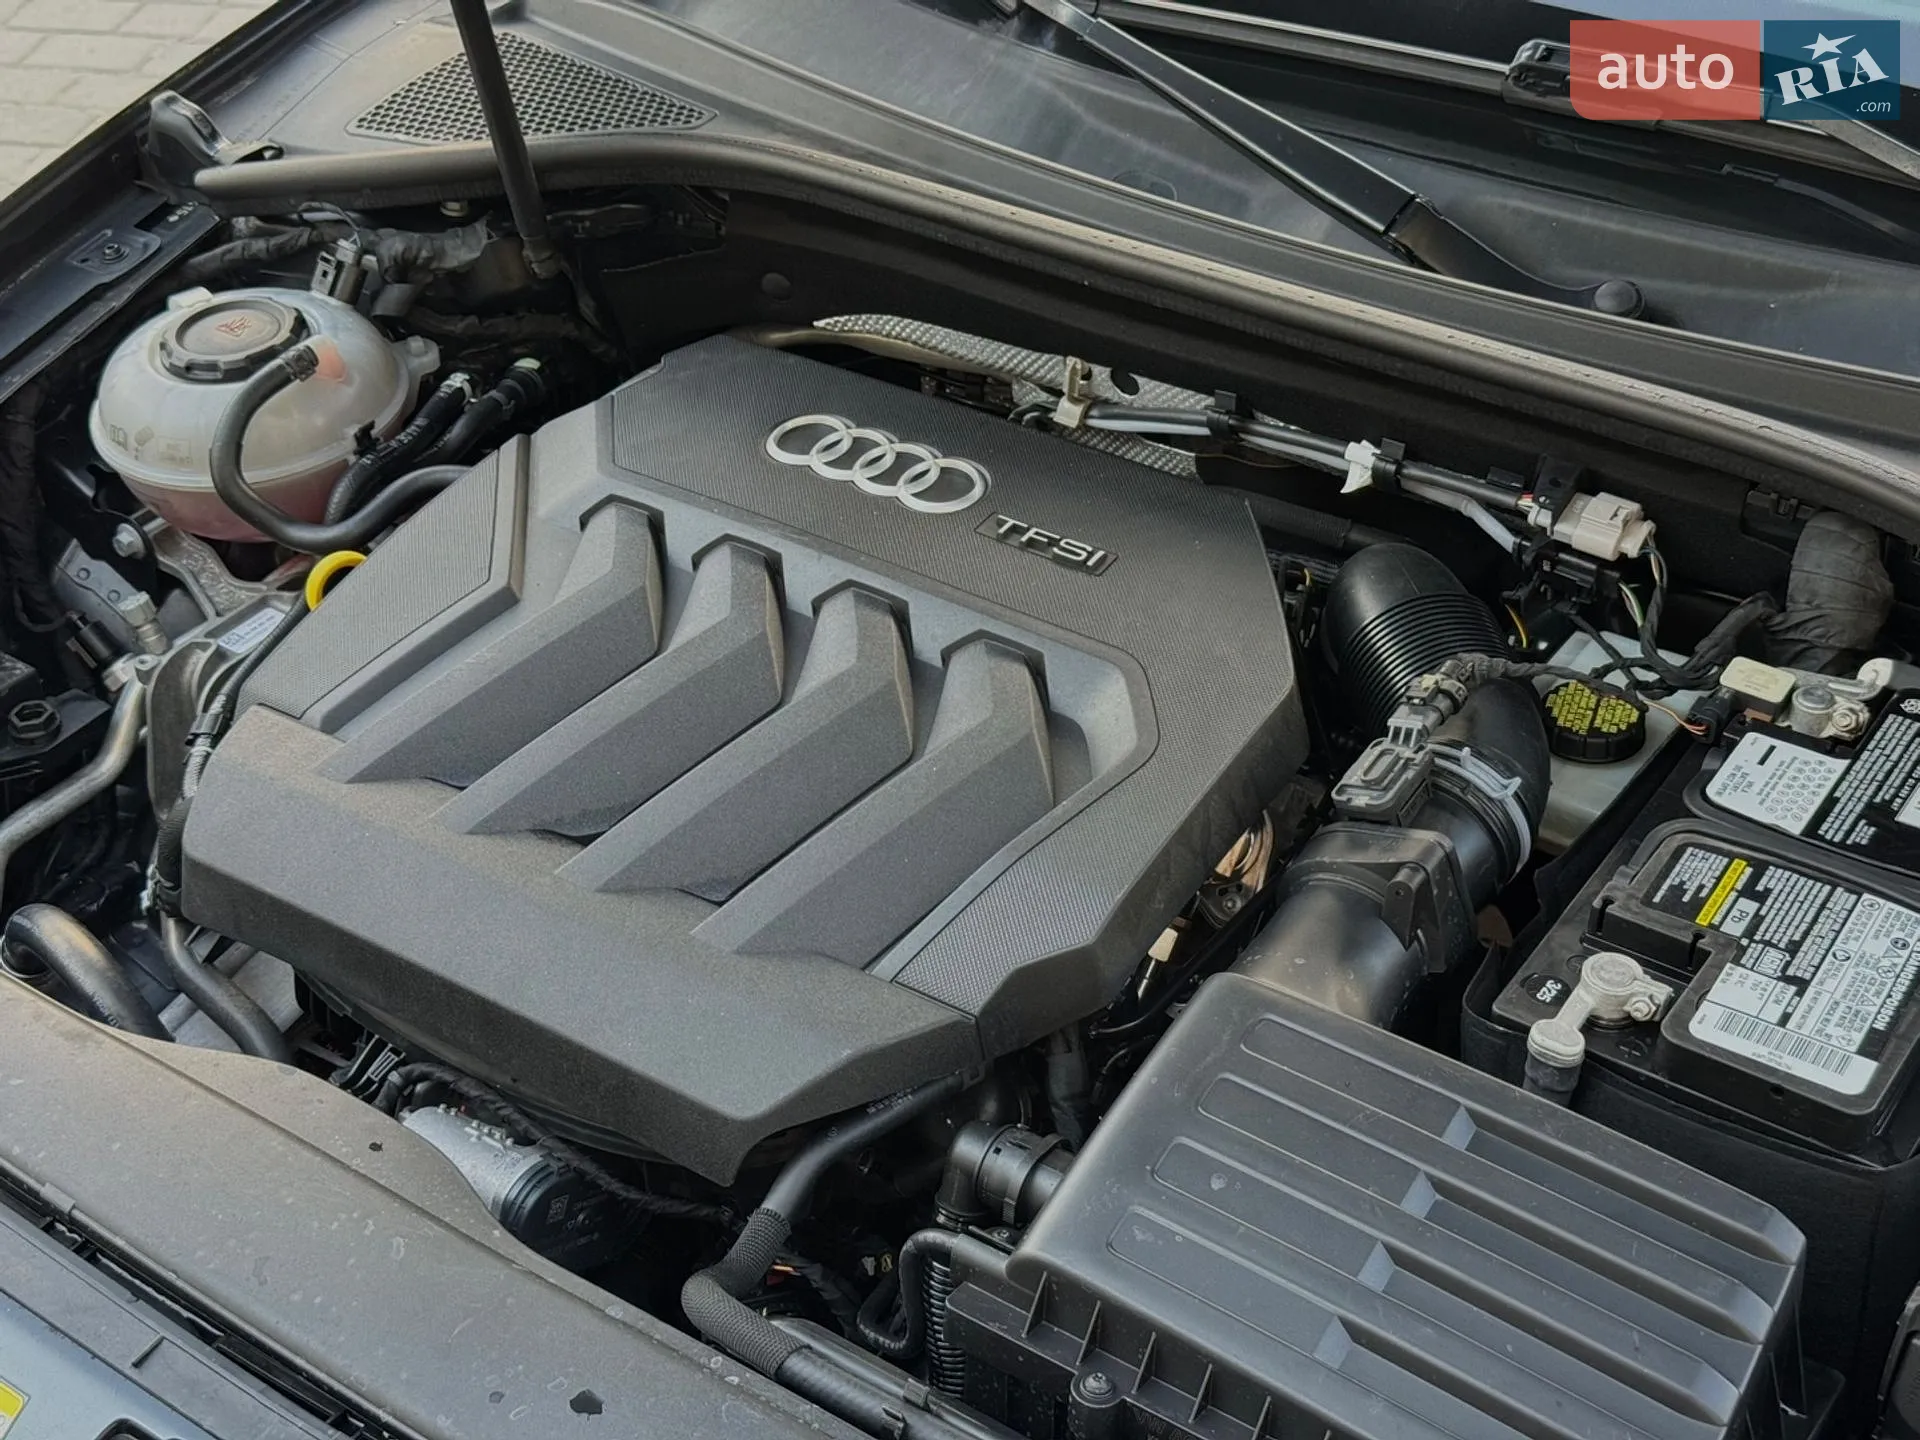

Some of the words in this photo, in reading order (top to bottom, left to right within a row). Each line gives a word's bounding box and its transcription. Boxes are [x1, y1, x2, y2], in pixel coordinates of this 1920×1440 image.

[996, 514, 1108, 567] TFSI
[1729, 907, 1749, 925] Pb
[1869, 952, 1920, 1031] DANGER/POISON
